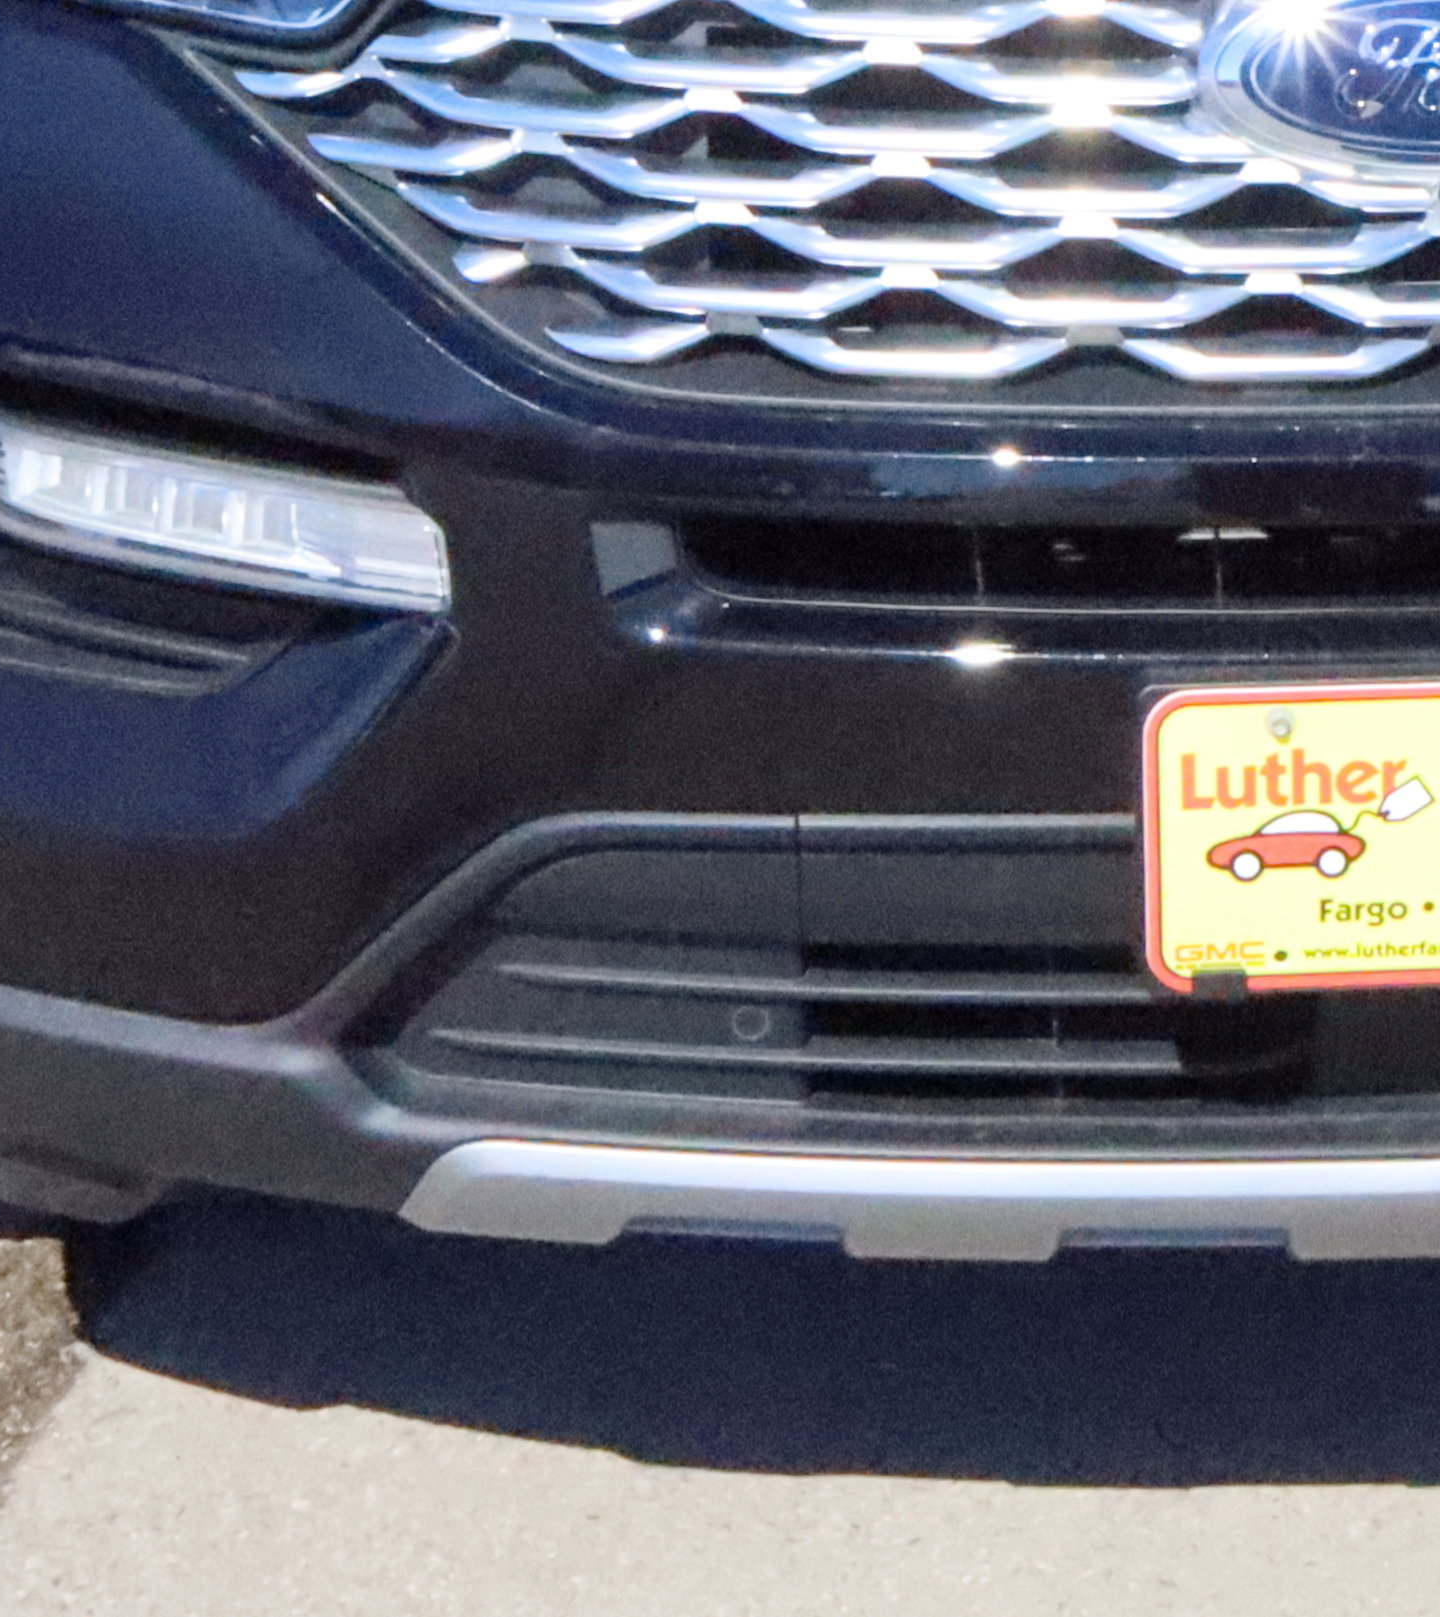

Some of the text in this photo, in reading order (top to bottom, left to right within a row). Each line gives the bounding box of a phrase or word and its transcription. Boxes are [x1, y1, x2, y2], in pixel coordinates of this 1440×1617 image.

[1181, 748, 1407, 810] Luther
[1318, 898, 1408, 926] Fargo
[1174, 941, 1265, 964] GMC
